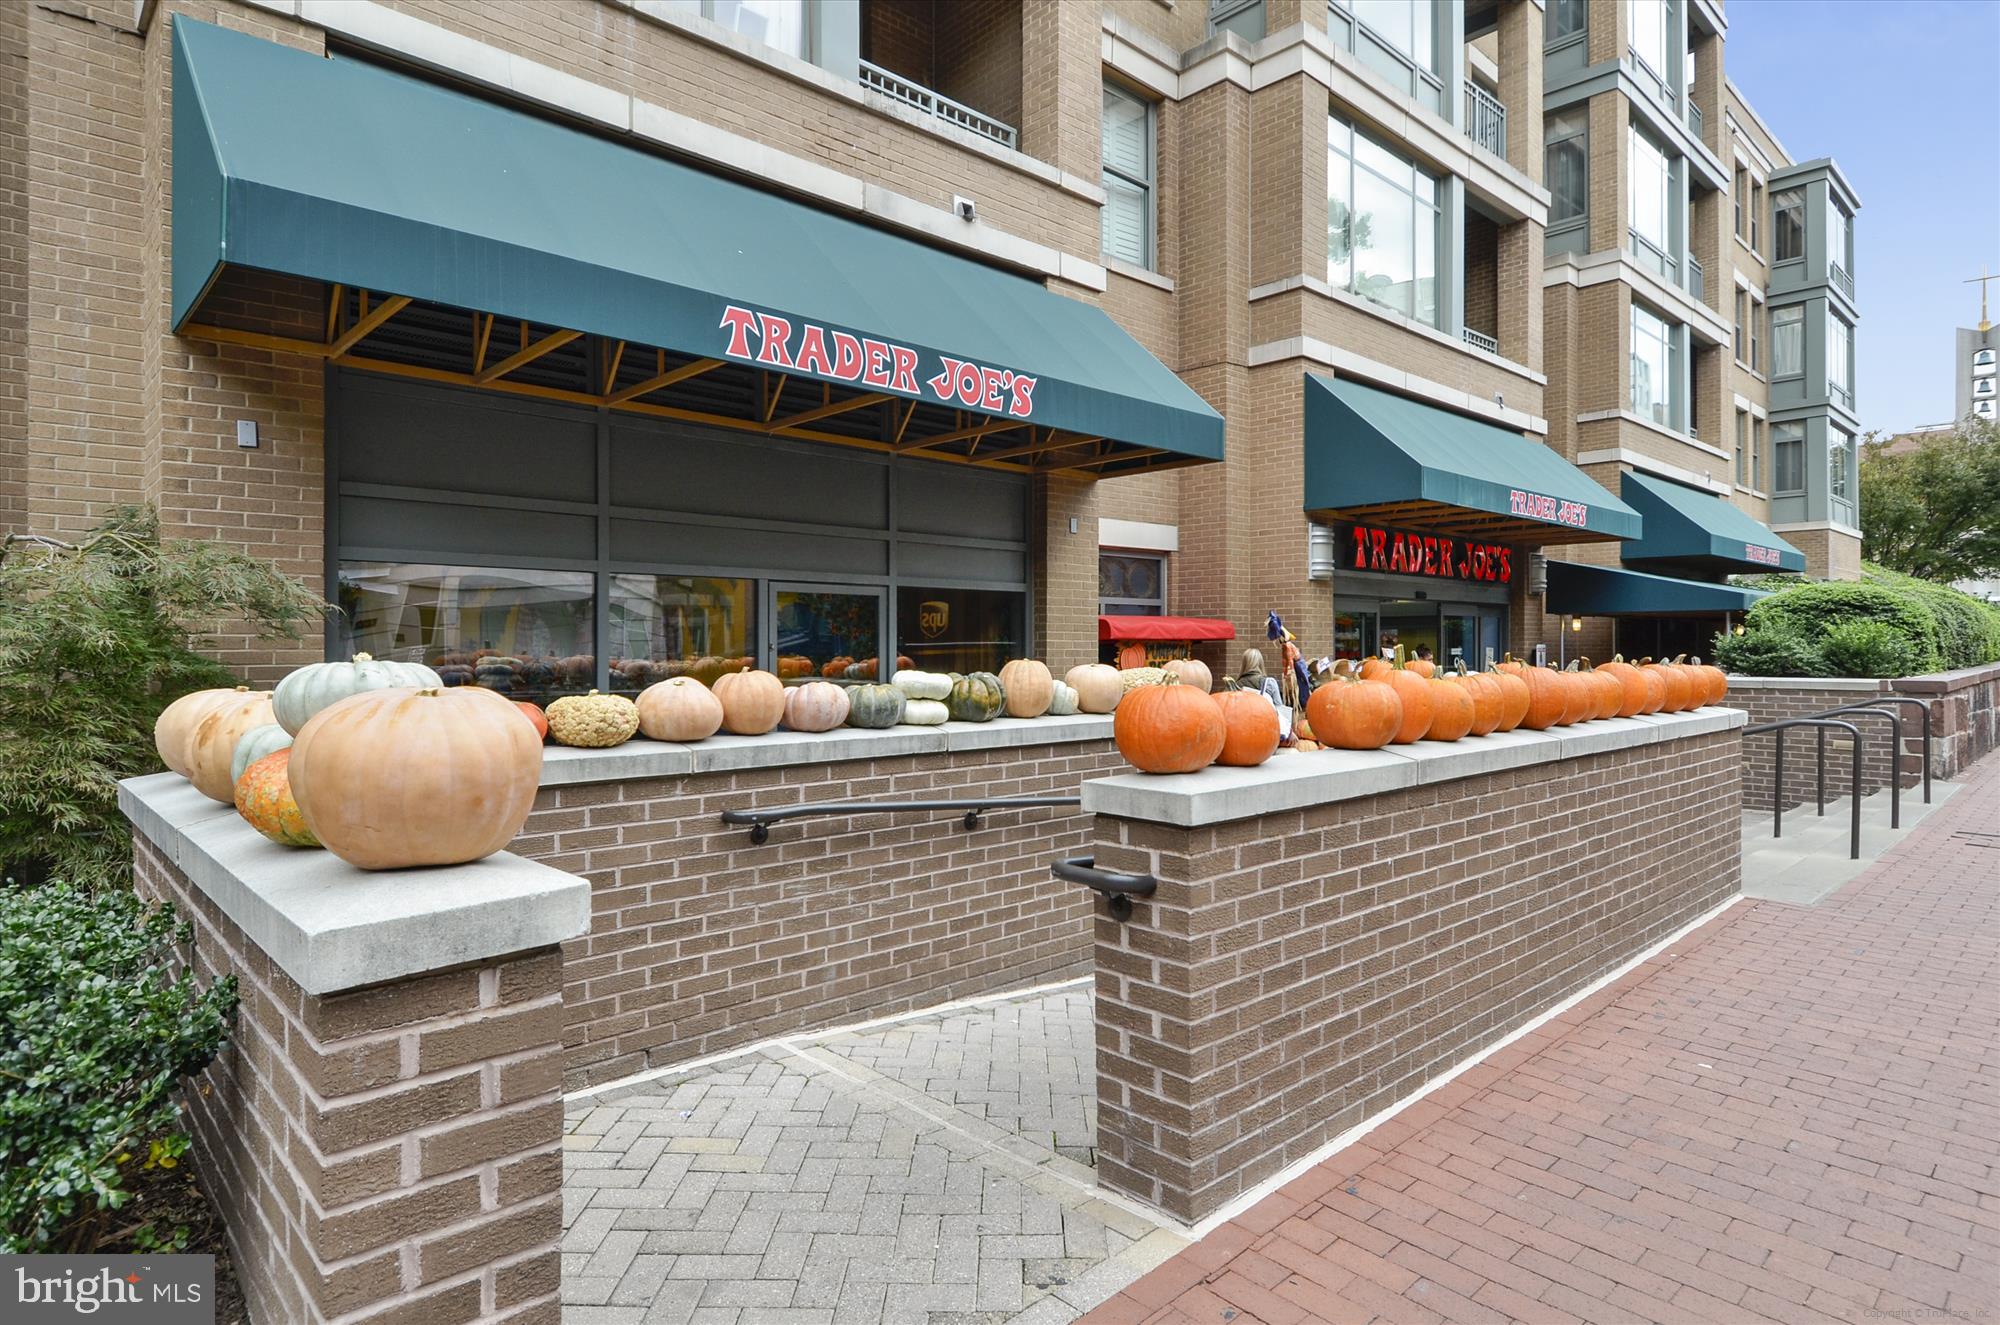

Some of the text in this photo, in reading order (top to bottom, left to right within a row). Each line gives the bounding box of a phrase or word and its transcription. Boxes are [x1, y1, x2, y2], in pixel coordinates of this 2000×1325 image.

[719, 304, 1038, 418] TRADER JOE'S
[1510, 490, 1588, 527] TRADER JOE'S
[1353, 526, 1512, 583] TRADER JOE'S
